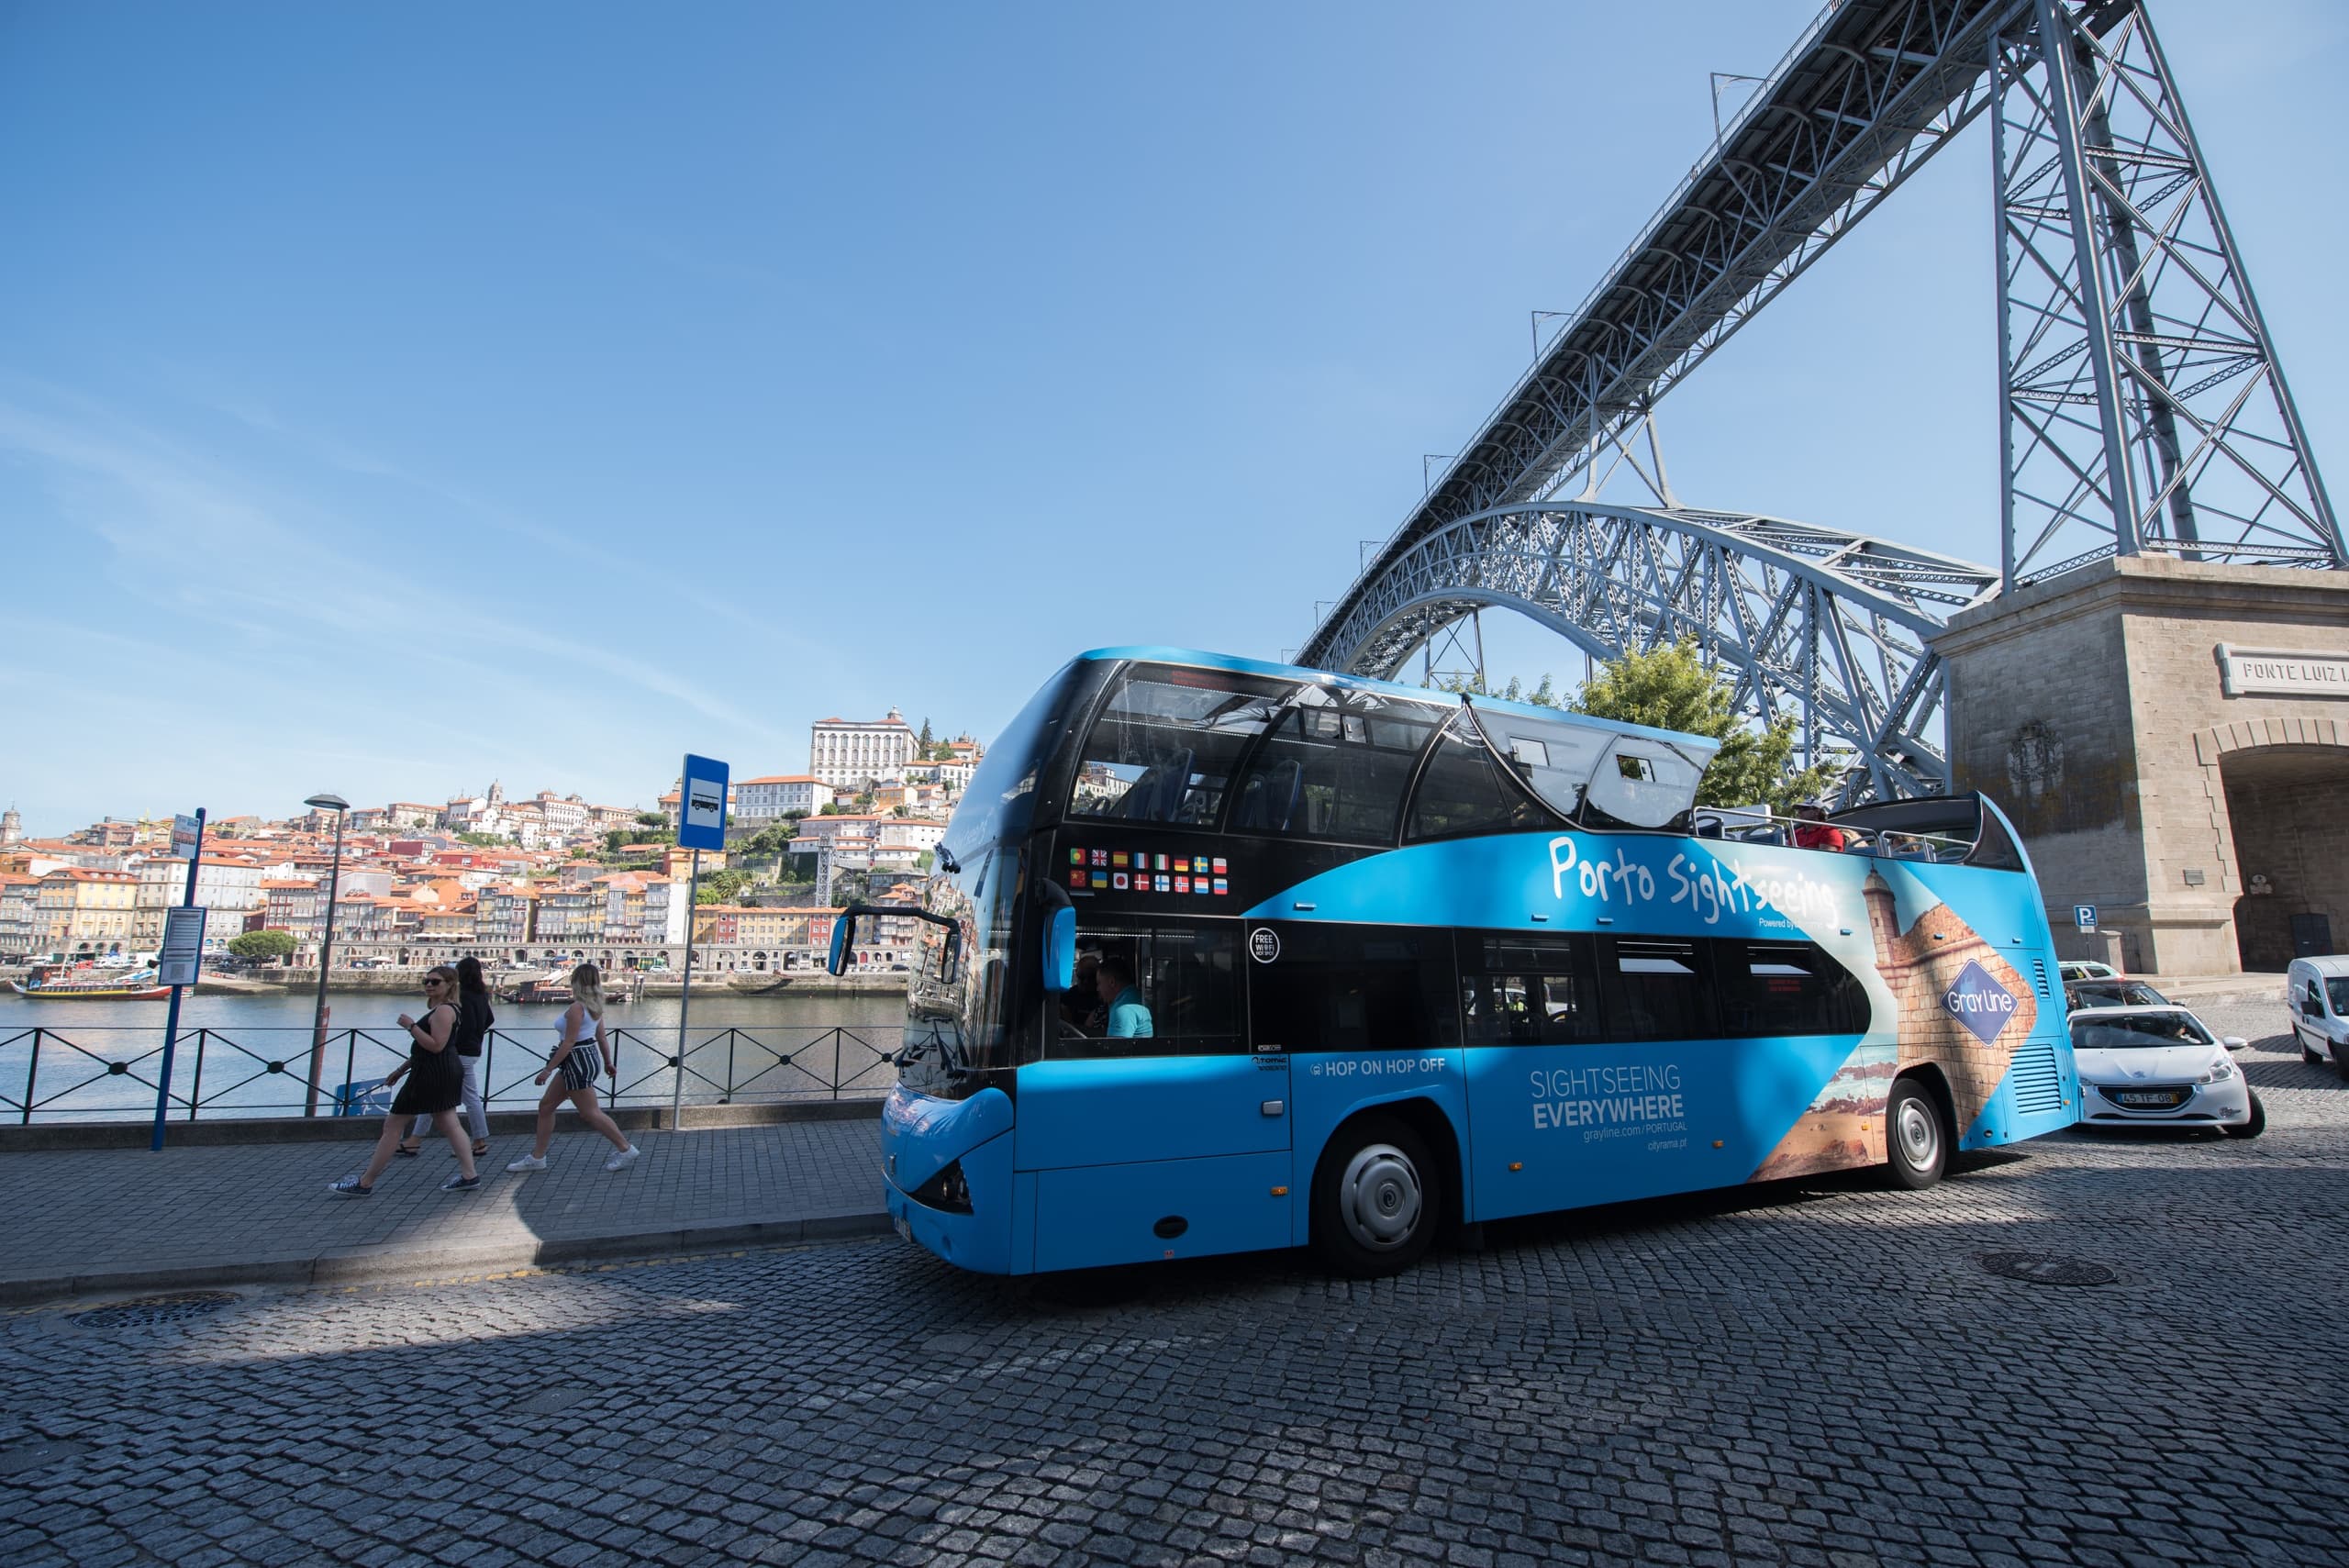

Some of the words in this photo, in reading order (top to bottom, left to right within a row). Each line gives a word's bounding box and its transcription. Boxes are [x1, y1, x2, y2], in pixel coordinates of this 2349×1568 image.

[2243, 662, 2298, 681] PONTE
[2301, 665, 2338, 682] LUIZ
[1549, 836, 1655, 906] Porto
[1667, 852, 1841, 930] Sightseeing
[1758, 917, 1786, 929] Powered
[1787, 918, 1795, 930] by
[2078, 907, 2092, 925] P
[1255, 934, 1274, 944] FREE
[1325, 1061, 1357, 1077] HOP
[1361, 1059, 1382, 1075] ON
[1386, 1058, 1416, 1073] HOP
[1419, 1057, 1446, 1073] OFF
[1530, 1064, 1682, 1099] SIGHTSEEING
[1533, 1094, 1685, 1129] EVERYWHERE
